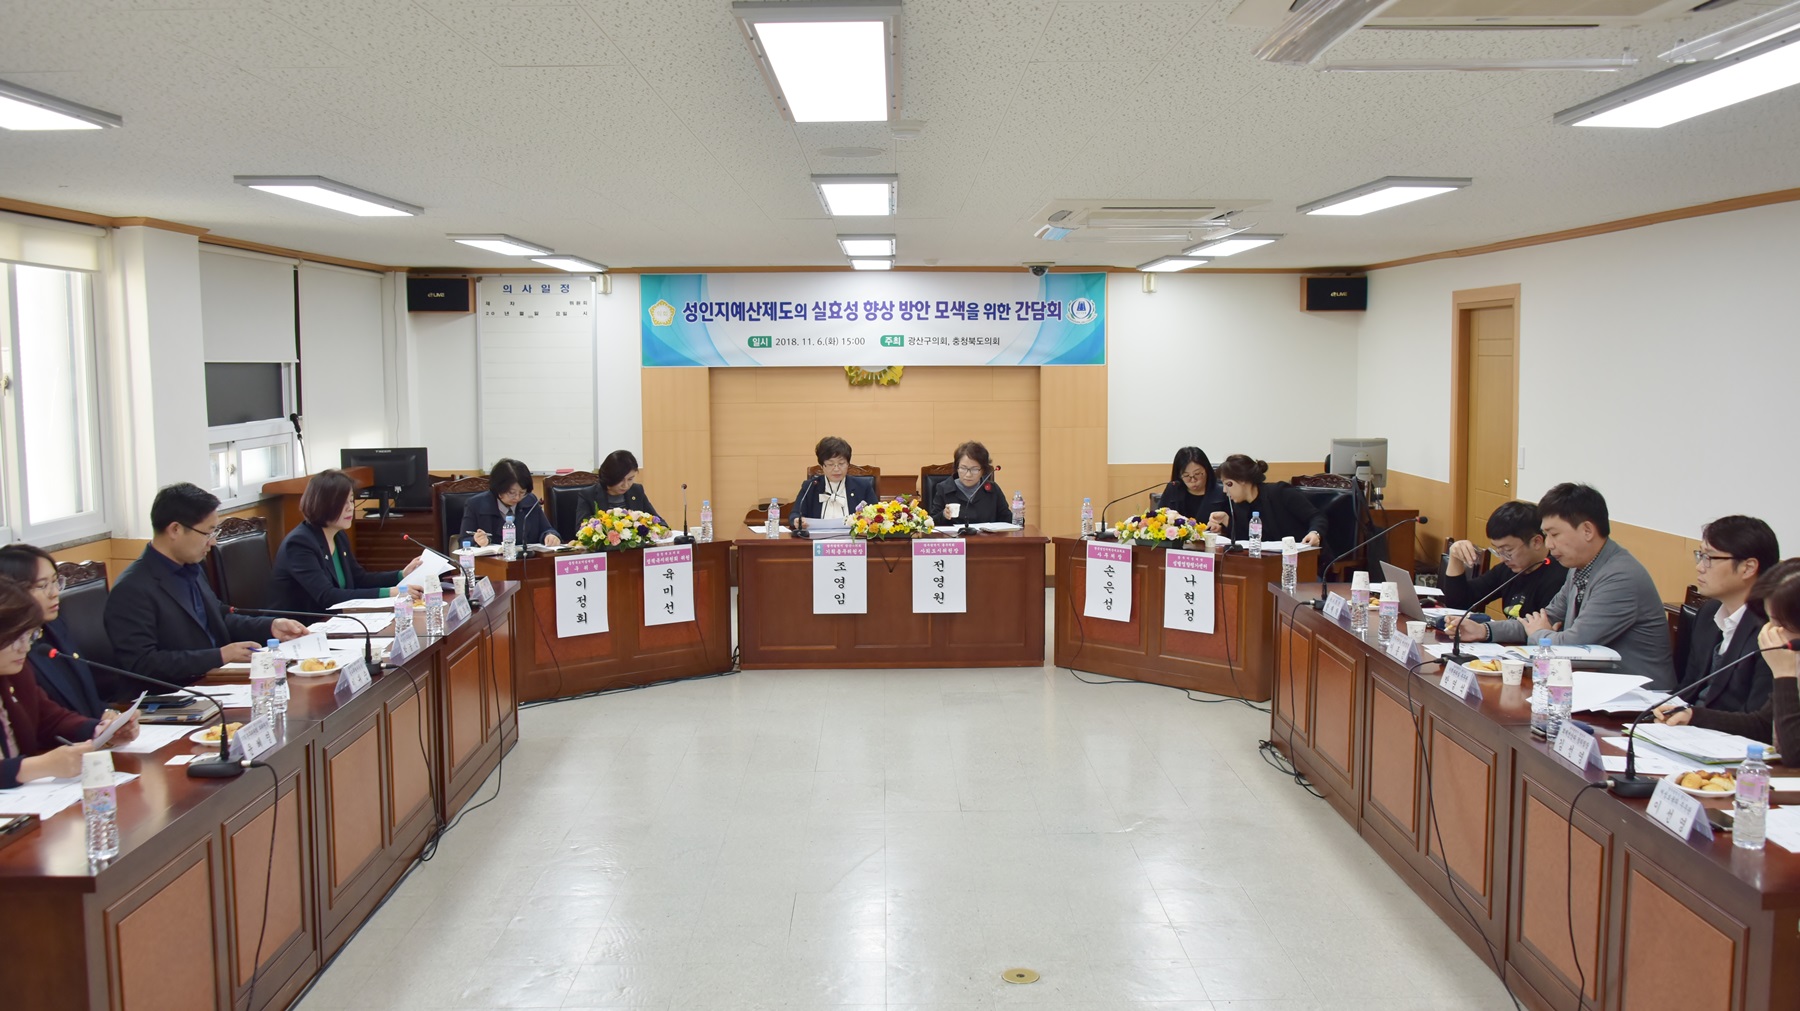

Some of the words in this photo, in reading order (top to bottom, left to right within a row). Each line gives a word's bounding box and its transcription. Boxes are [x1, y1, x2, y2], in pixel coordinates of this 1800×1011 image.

[683, 301, 807, 322] 성인지예산제도의
[811, 301, 858, 321] 실효성
[863, 301, 895, 321] 향상
[899, 301, 931, 321] 방안
[935, 301, 980, 321] 모색을
[982, 302, 1012, 321] 위한
[1015, 301, 1062, 321] 간담회
[752, 338, 768, 347] 일시
[775, 338, 799, 346] 2018.
[802, 338, 815, 346] 11.
[817, 338, 839, 347] 6.(화)
[842, 338, 866, 346] 15:00
[884, 337, 901, 347] 주최
[908, 337, 950, 347] 광산구의회,
[953, 337, 1000, 347] 충청북도의회
[662, 568, 675, 614] 육미선
[834, 561, 847, 605] 조영임
[933, 560, 945, 605] 전영원
[1104, 564, 1115, 611] 손은성
[1184, 574, 1197, 622] 나현정
